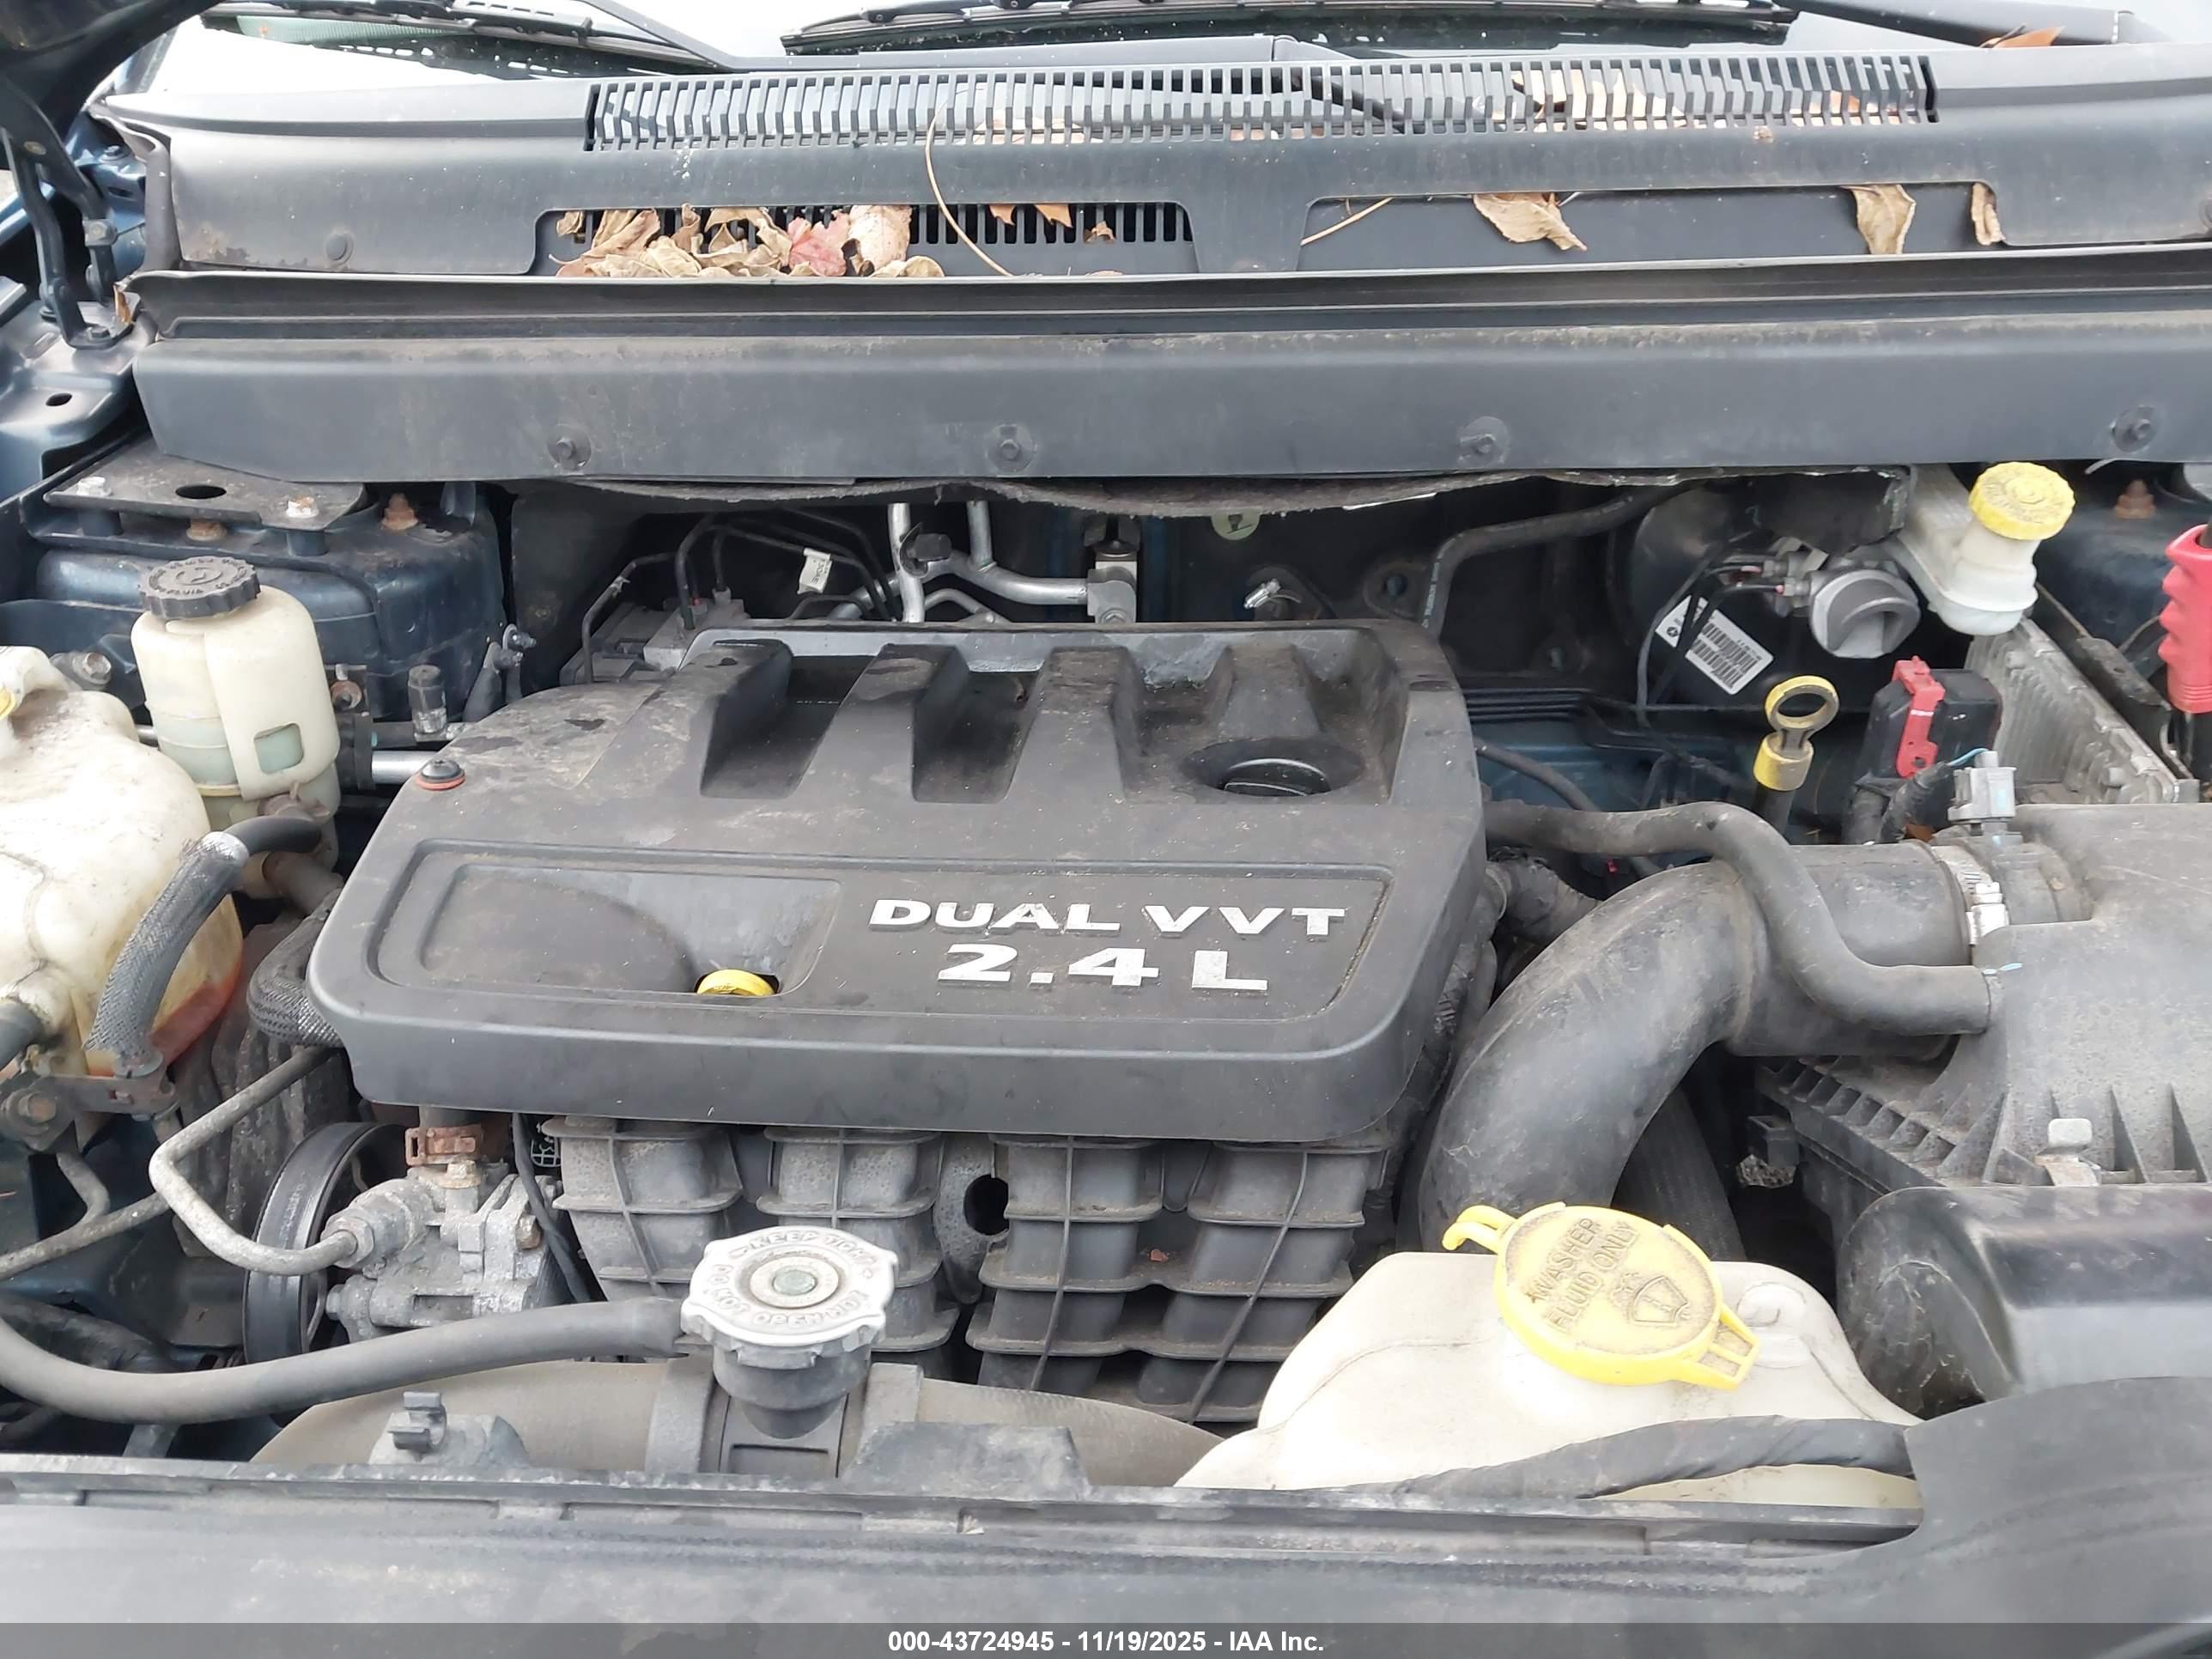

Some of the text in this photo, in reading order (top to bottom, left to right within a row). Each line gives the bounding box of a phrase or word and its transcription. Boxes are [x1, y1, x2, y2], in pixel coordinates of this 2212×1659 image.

[869, 898, 1346, 938] DUAL VVT
[938, 943, 1268, 992] 2.4 L
[750, 1231, 819, 1249] KEEP
[1525, 1218, 1602, 1304] WASHER
[1545, 1219, 1641, 1328] FLUID ONLY
[712, 1286, 751, 1314] NOT
[752, 1310, 823, 1328] OPEN
